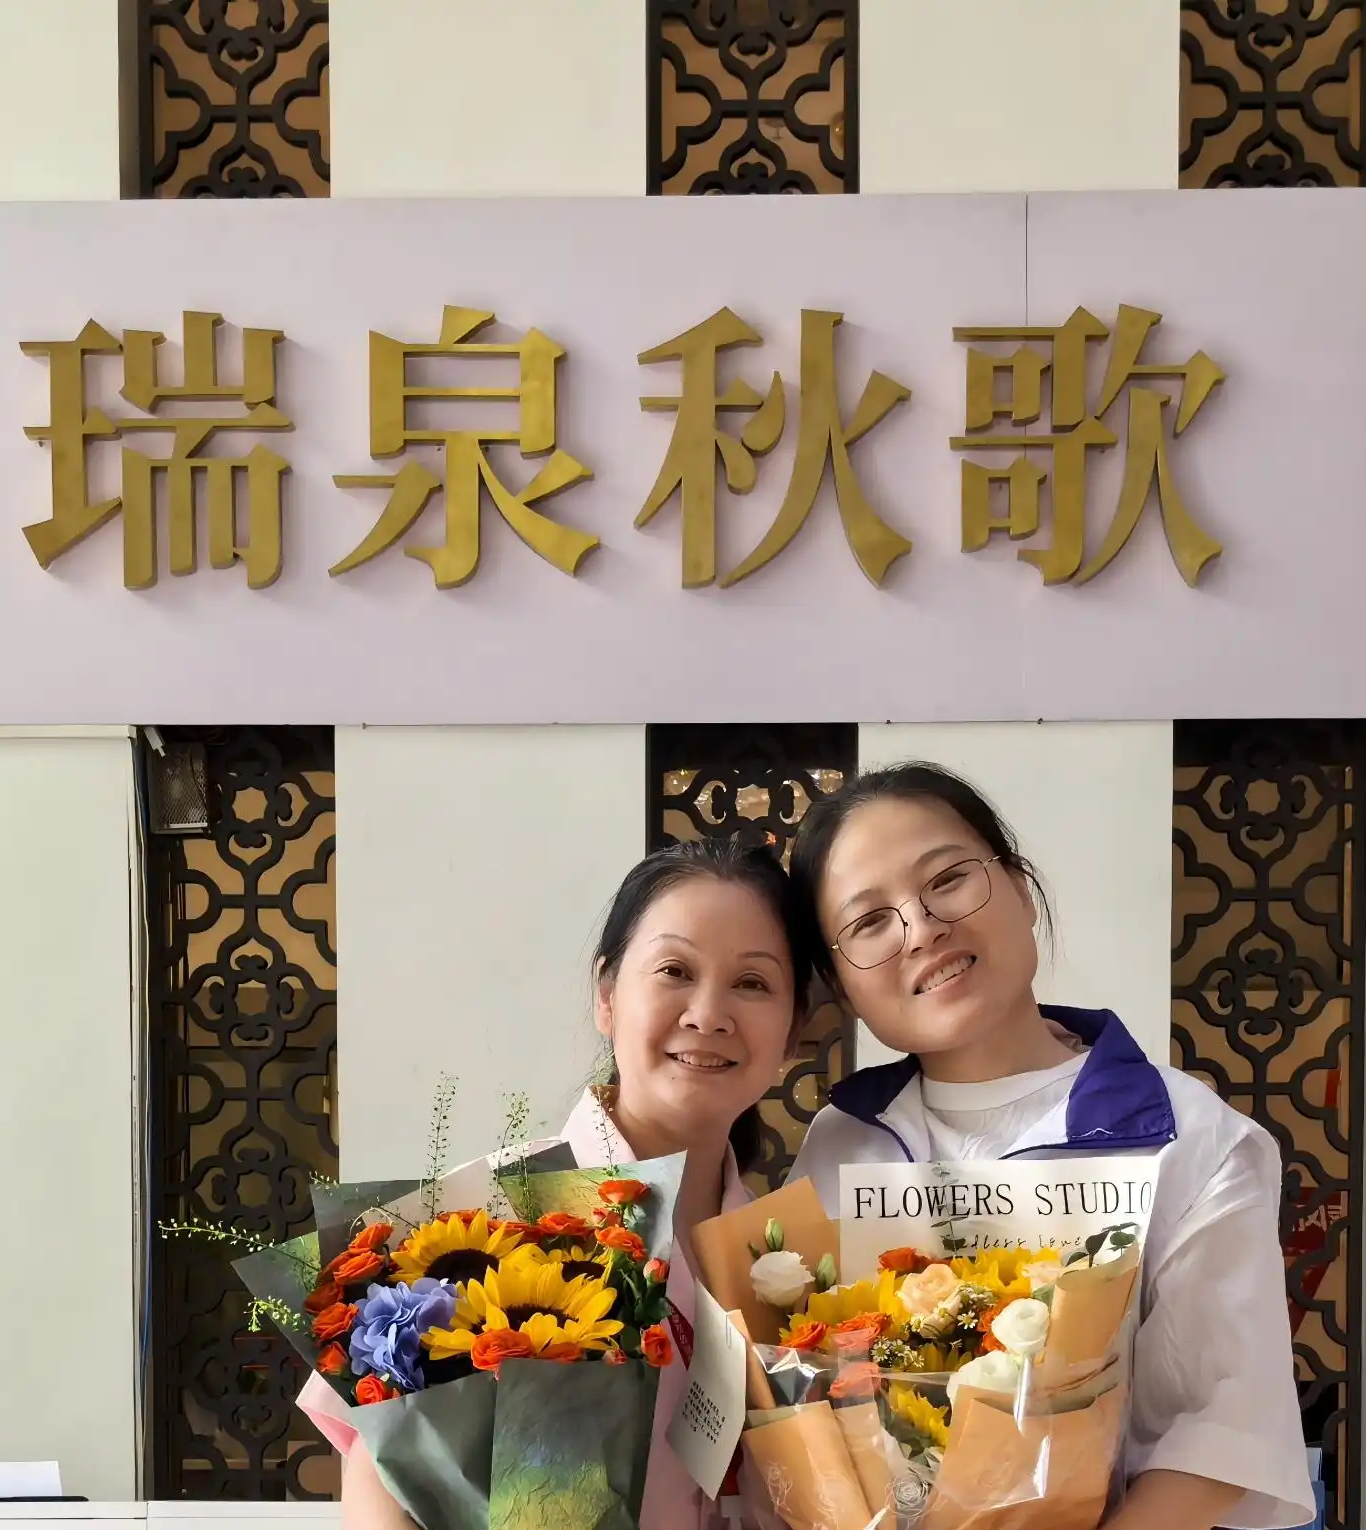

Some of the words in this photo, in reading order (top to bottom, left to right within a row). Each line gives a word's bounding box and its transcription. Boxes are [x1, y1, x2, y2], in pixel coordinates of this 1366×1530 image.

[21, 303, 1226, 590] 瑞泉秋歌
[853, 1182, 1015, 1220] FLOWERS
[1035, 1180, 1152, 1216] STUDIO
